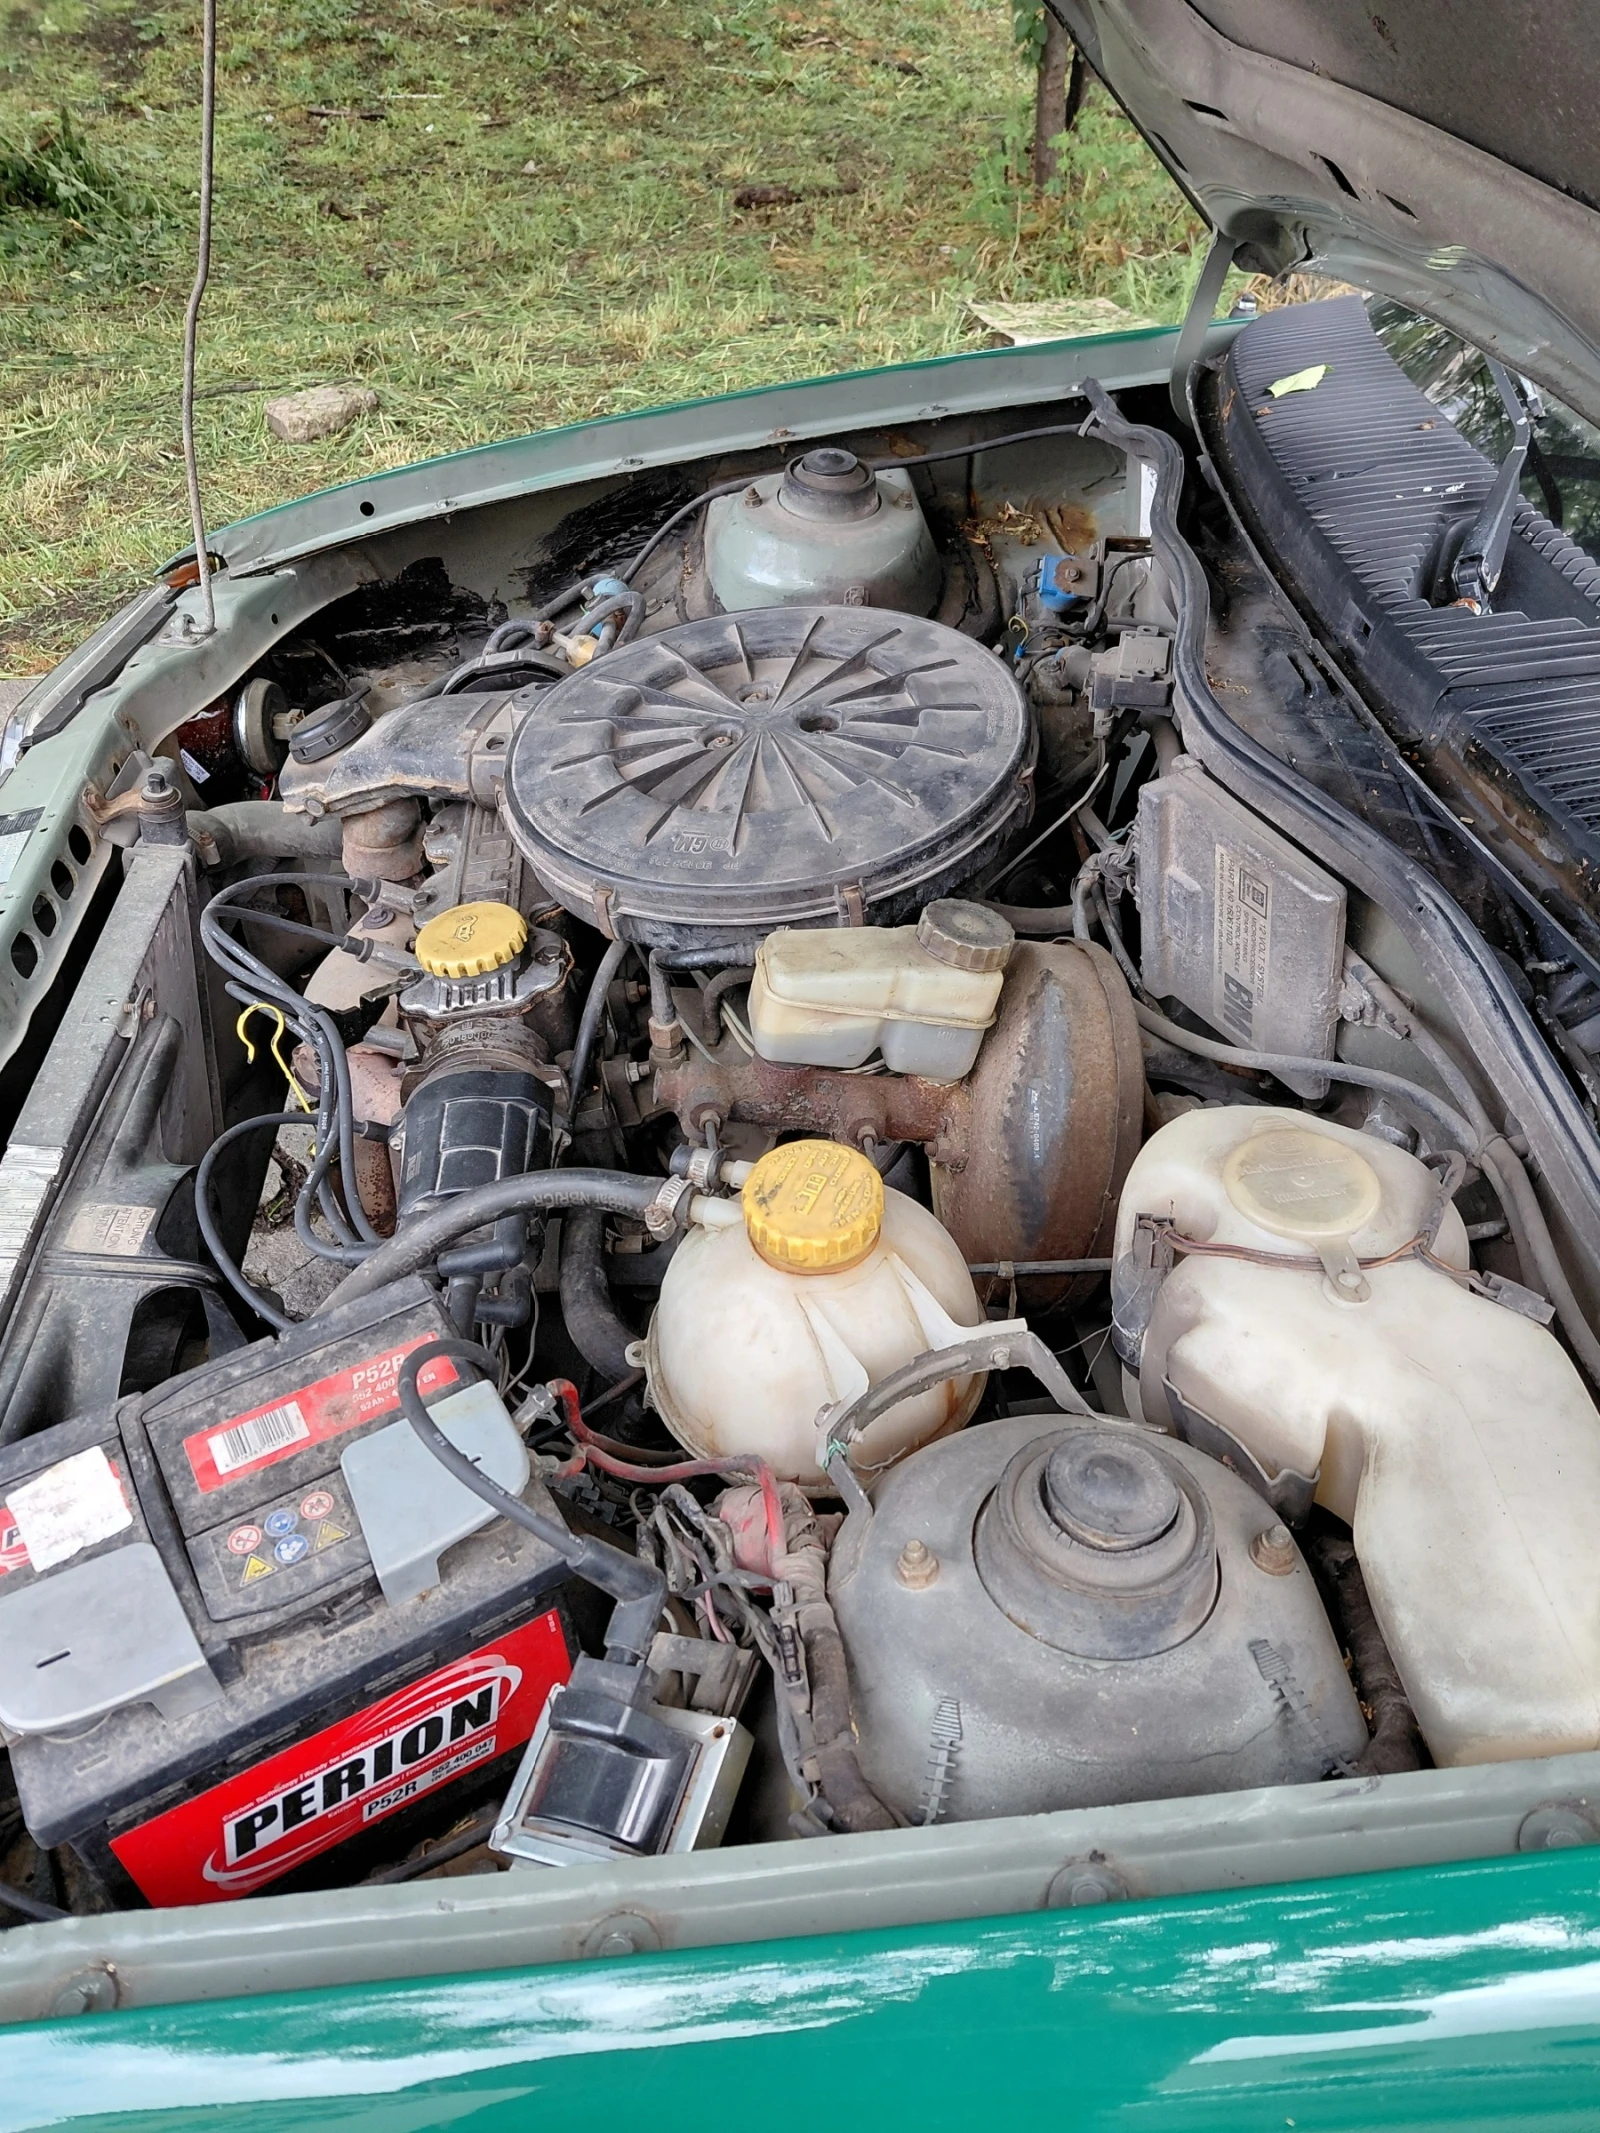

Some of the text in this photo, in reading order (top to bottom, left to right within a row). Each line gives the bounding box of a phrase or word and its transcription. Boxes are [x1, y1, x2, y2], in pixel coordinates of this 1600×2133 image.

[674, 837, 707, 854] GM
[1249, 916, 1257, 985] MICROPROCESSOR
[1256, 924, 1267, 1003] 12 VOLT SYSTEM
[321, 1111, 329, 1130] BOSCH
[107, 1207, 132, 1248] ATTENTION
[128, 1208, 151, 1246] ACHTUNG
[352, 1377, 395, 1404] 552 400
[422, 1372, 437, 1384] EN
[235, 1685, 493, 1859] PERION
[432, 1737, 494, 1777] 552 400 047
[367, 1781, 417, 1817] P52R
